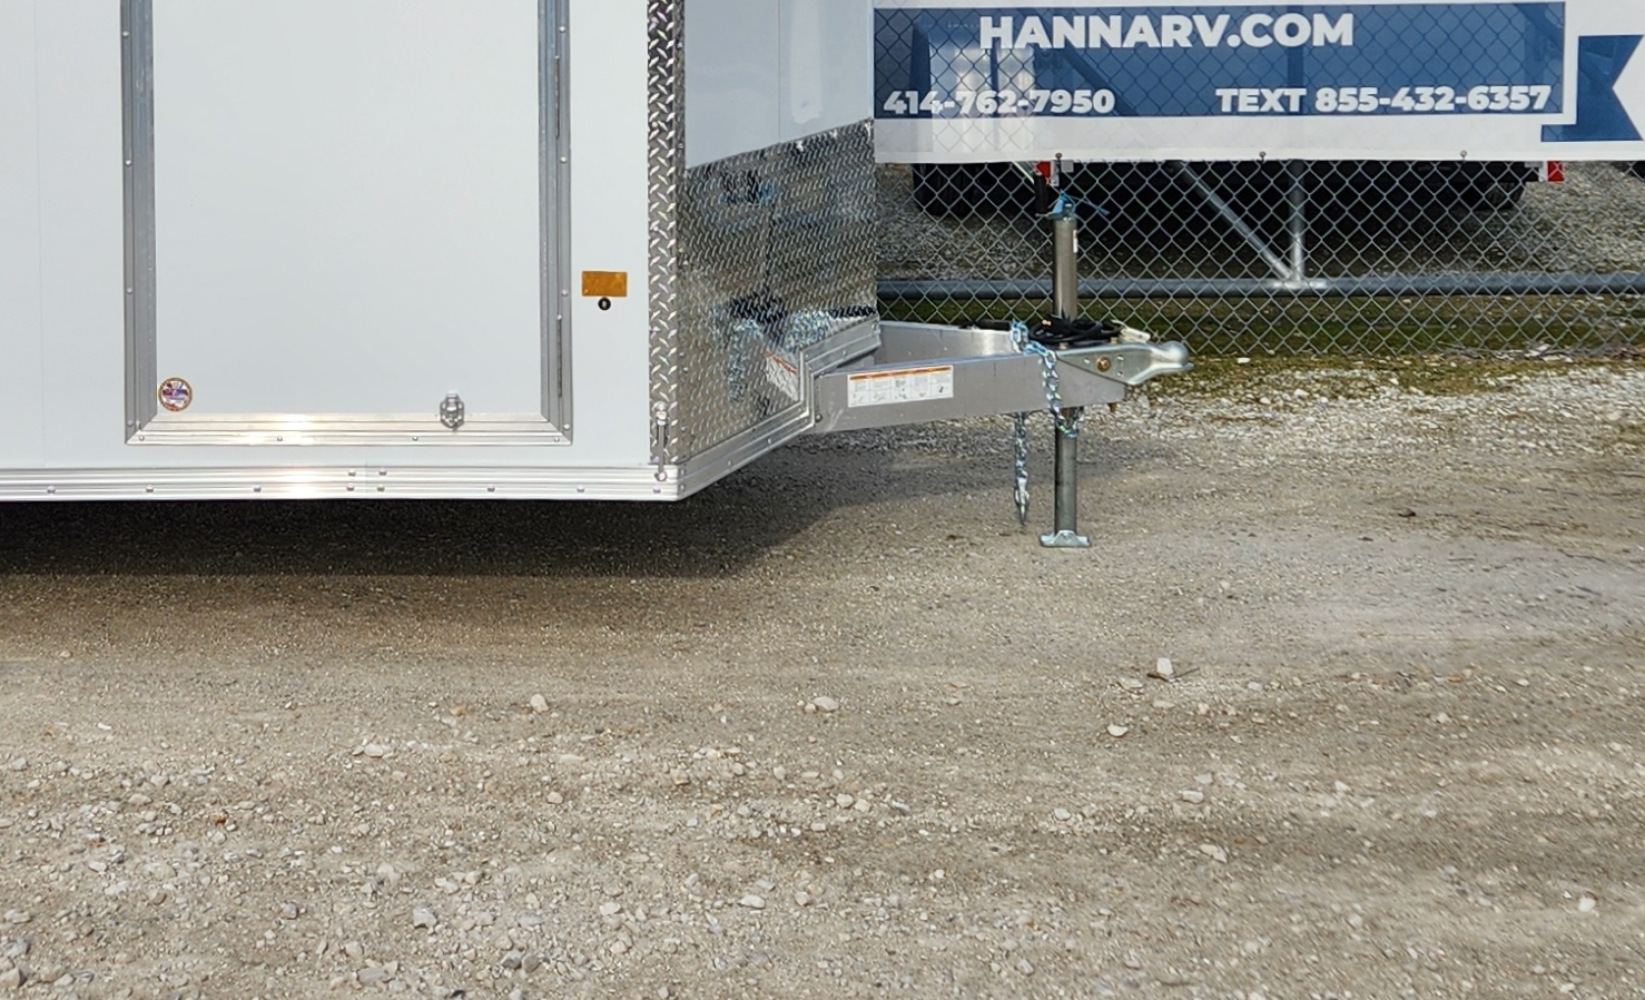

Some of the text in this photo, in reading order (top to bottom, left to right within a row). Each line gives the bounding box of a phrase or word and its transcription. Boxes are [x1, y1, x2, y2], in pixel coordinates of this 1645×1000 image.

[979, 12, 1353, 50] HANNARV.COM
[883, 89, 1115, 115] 414-762-7950
[1215, 85, 1552, 113] TEXT 855-432-6357
